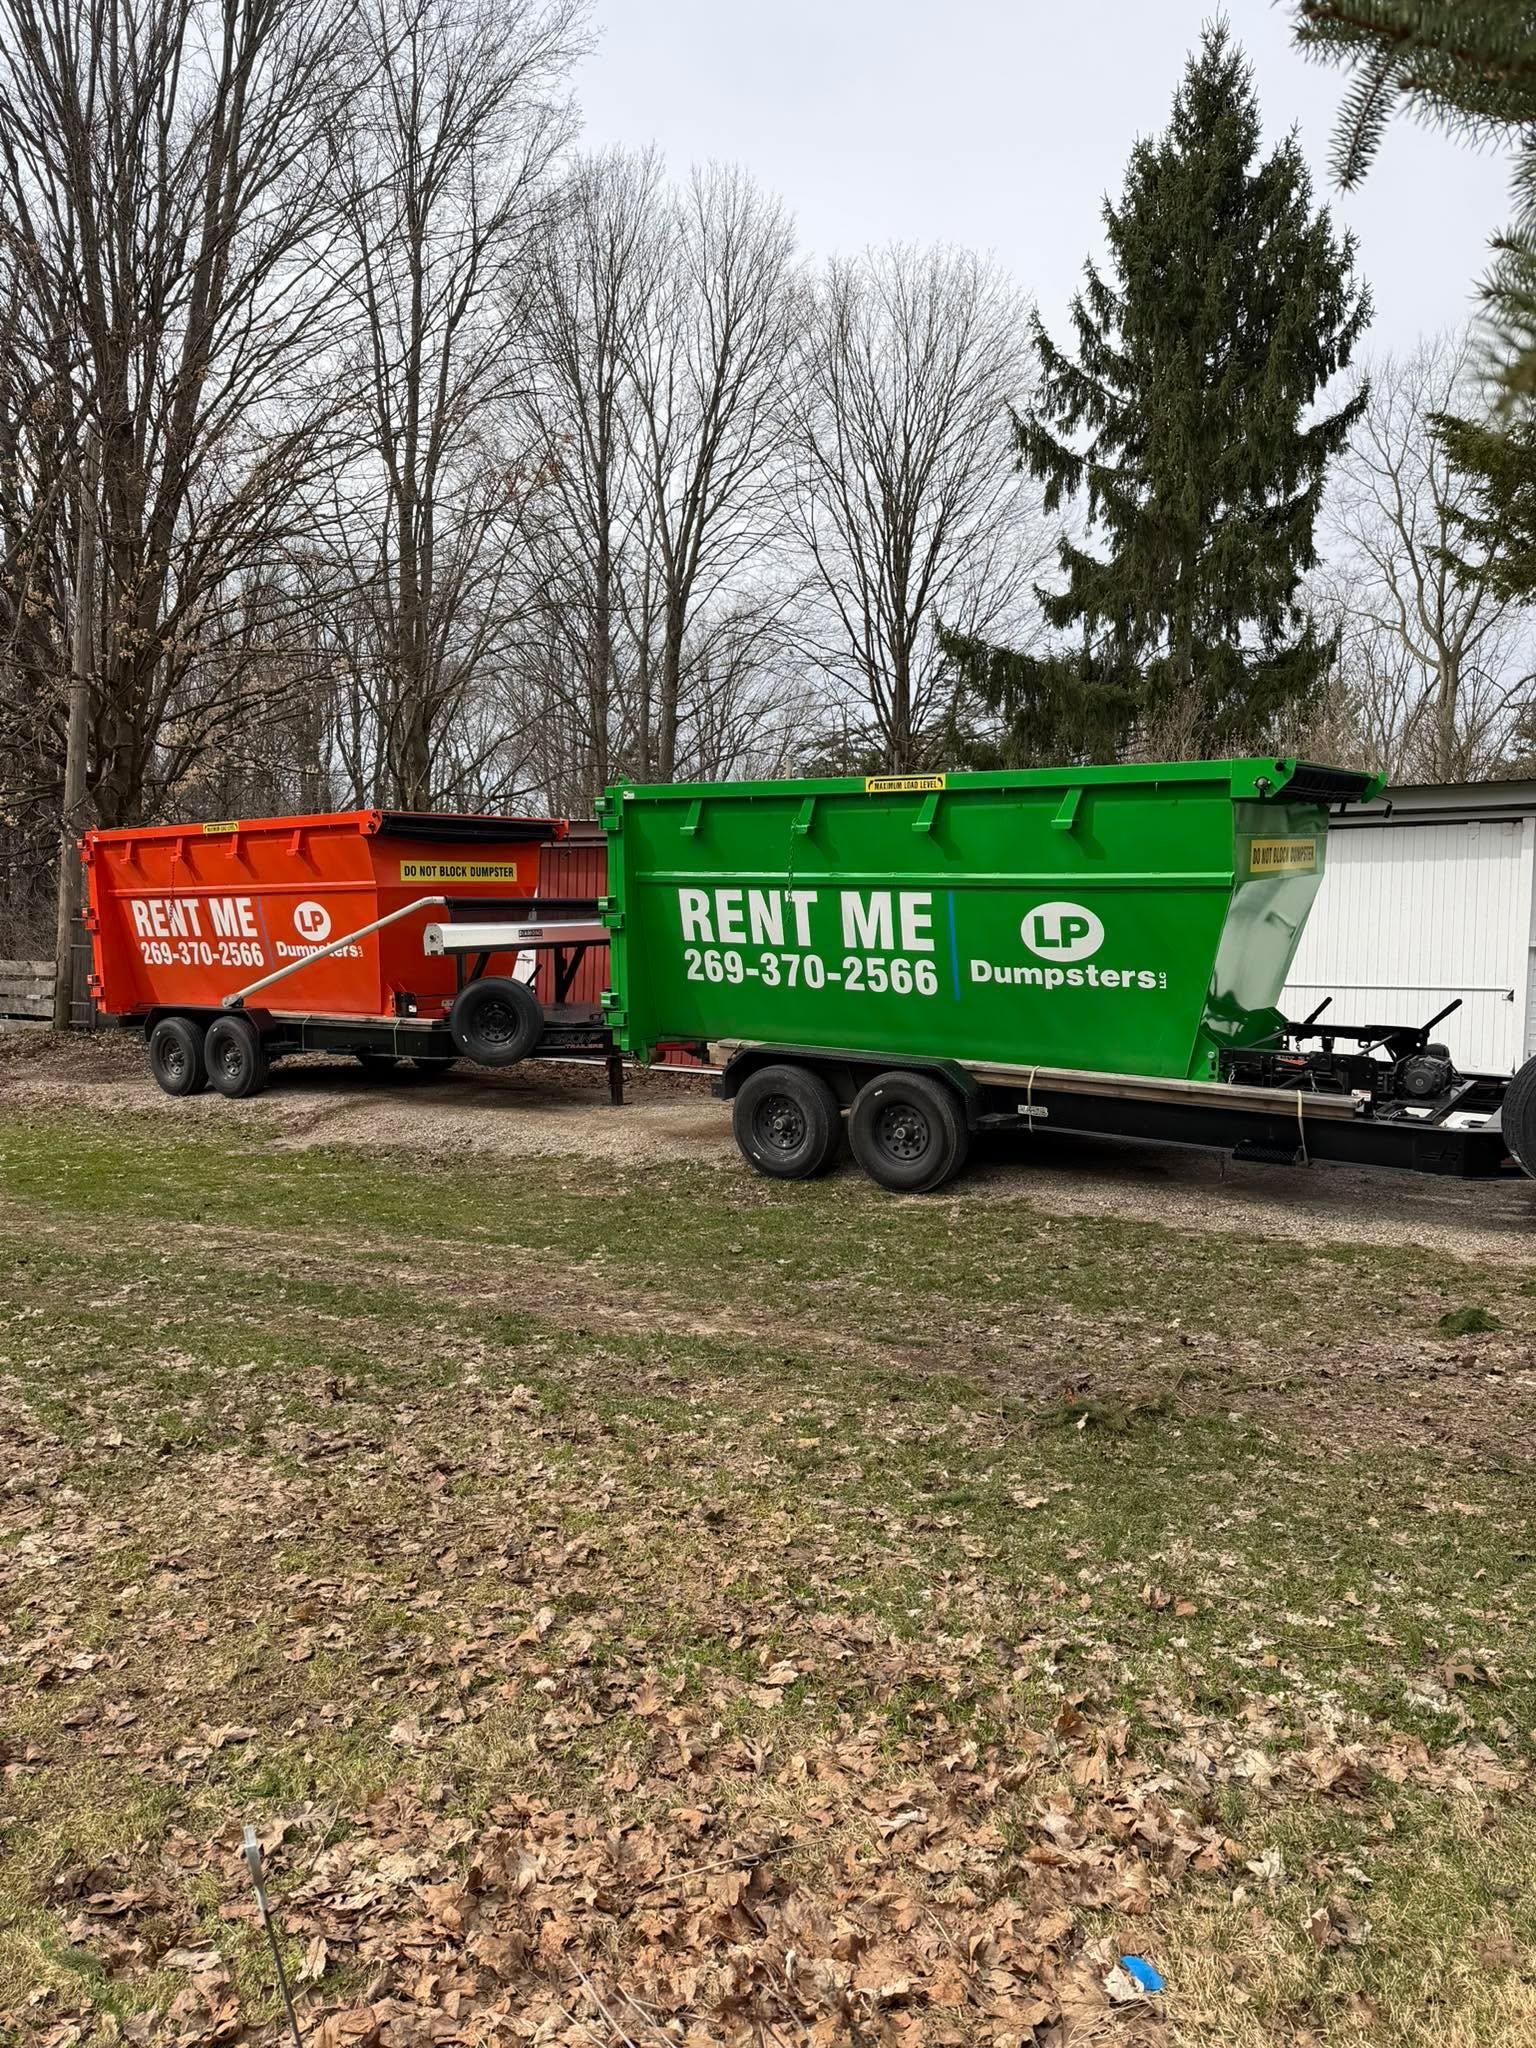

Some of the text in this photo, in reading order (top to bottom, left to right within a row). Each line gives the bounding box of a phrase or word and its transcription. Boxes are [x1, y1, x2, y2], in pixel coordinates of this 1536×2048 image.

[874, 780, 937, 790] MAXIMUM LOAD LEVEL
[404, 865, 514, 878] DO NOT BLOCK DUMPSTER
[131, 897, 258, 937] RENT ME
[298, 910, 325, 932] LP
[678, 888, 935, 951] RENT ME
[1033, 915, 1090, 948] LP
[141, 941, 264, 967] 269-370-2566
[684, 948, 938, 996] 269-370-2566
[970, 959, 1167, 989] Dumpsters LLC
